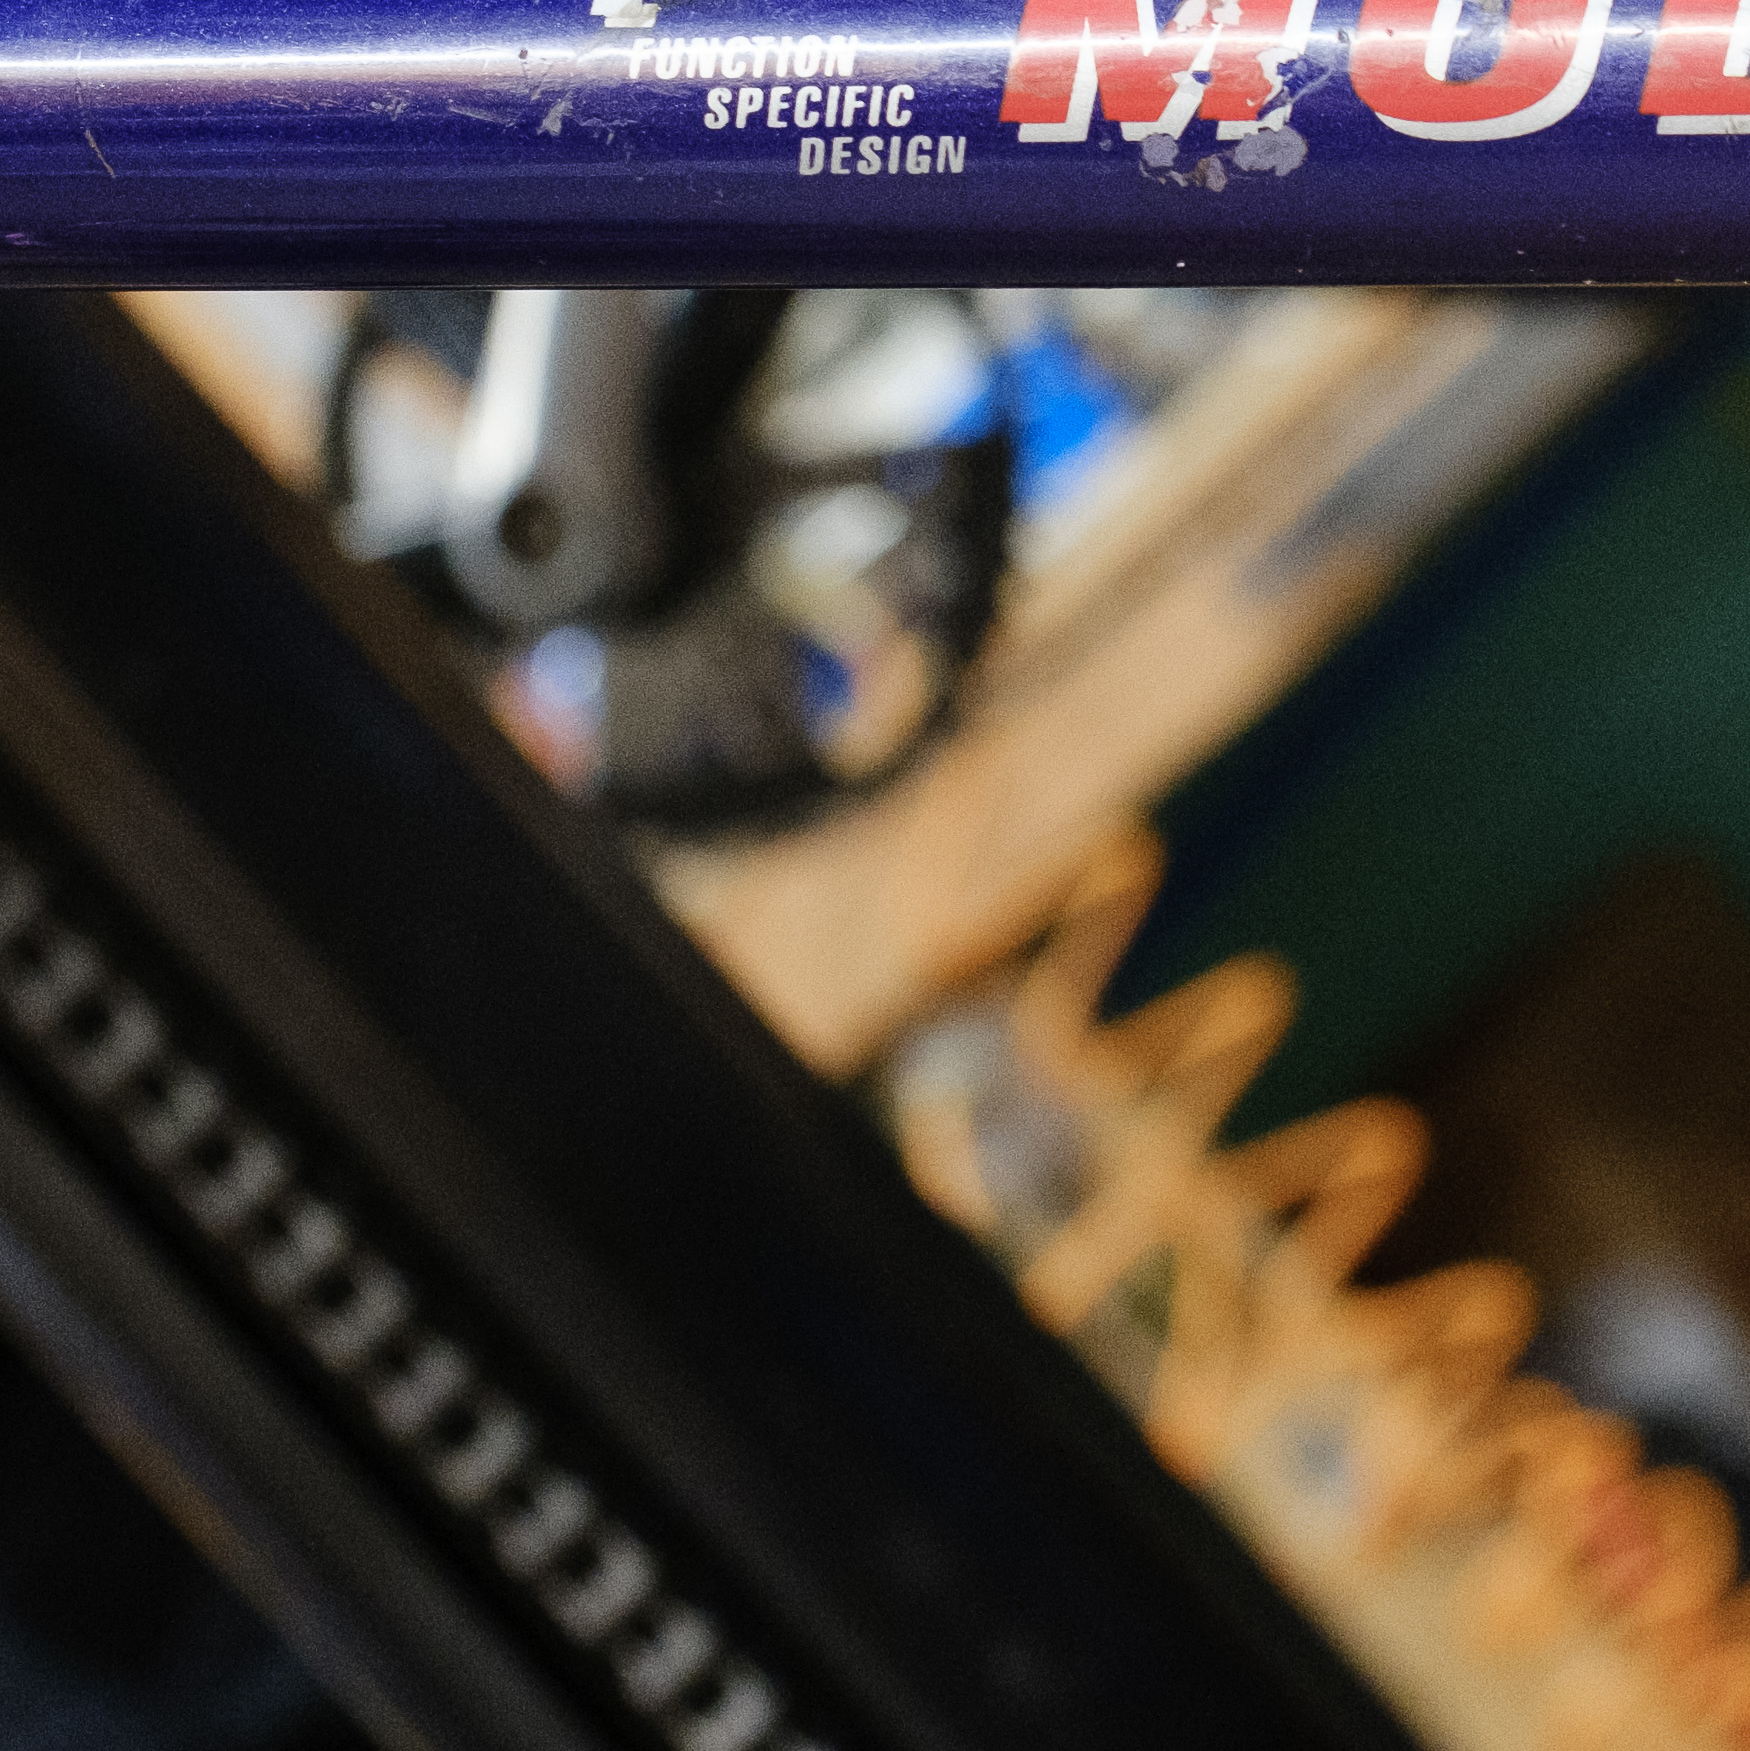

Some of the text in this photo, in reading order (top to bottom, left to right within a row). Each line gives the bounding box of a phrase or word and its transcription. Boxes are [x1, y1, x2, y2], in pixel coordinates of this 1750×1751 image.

[628, 34, 860, 80] FUNCTION
[703, 84, 915, 129] SPECIFIC
[799, 135, 967, 176] DESIGN
